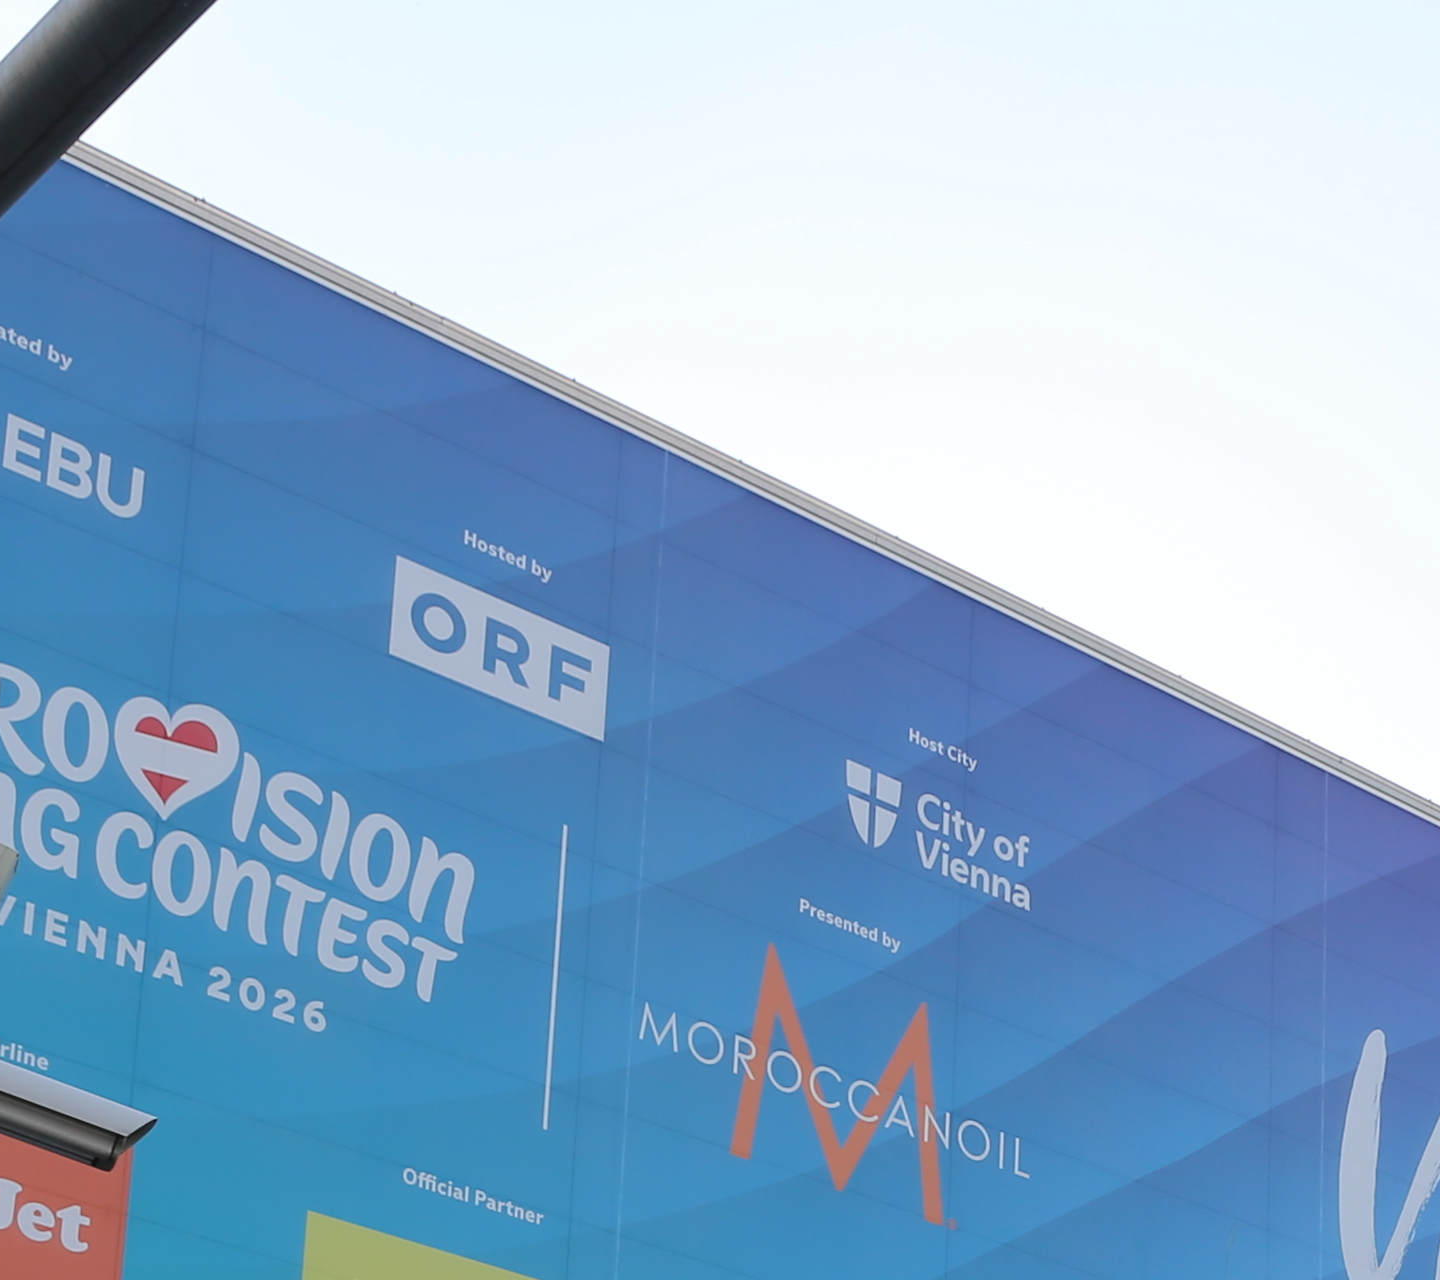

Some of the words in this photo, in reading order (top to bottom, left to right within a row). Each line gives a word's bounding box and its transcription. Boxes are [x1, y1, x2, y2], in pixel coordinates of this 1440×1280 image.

[44, 347, 74, 372] by
[2, 412, 146, 519] EBU
[463, 529, 528, 574] Hosted
[530, 560, 553, 584] by
[410, 592, 592, 701] ORF
[908, 727, 944, 757] Host
[946, 739, 978, 772] City
[916, 793, 986, 857] City
[993, 830, 1031, 868] of
[915, 829, 1032, 912] Vienna
[95, 811, 458, 1003] CONTEST
[798, 897, 874, 946] Presented
[876, 926, 901, 953] by
[208, 966, 328, 1033] 2026
[638, 1002, 1031, 1179] MOROCCANOIL
[402, 1166, 472, 1206] Official
[474, 1189, 545, 1227] Partner
